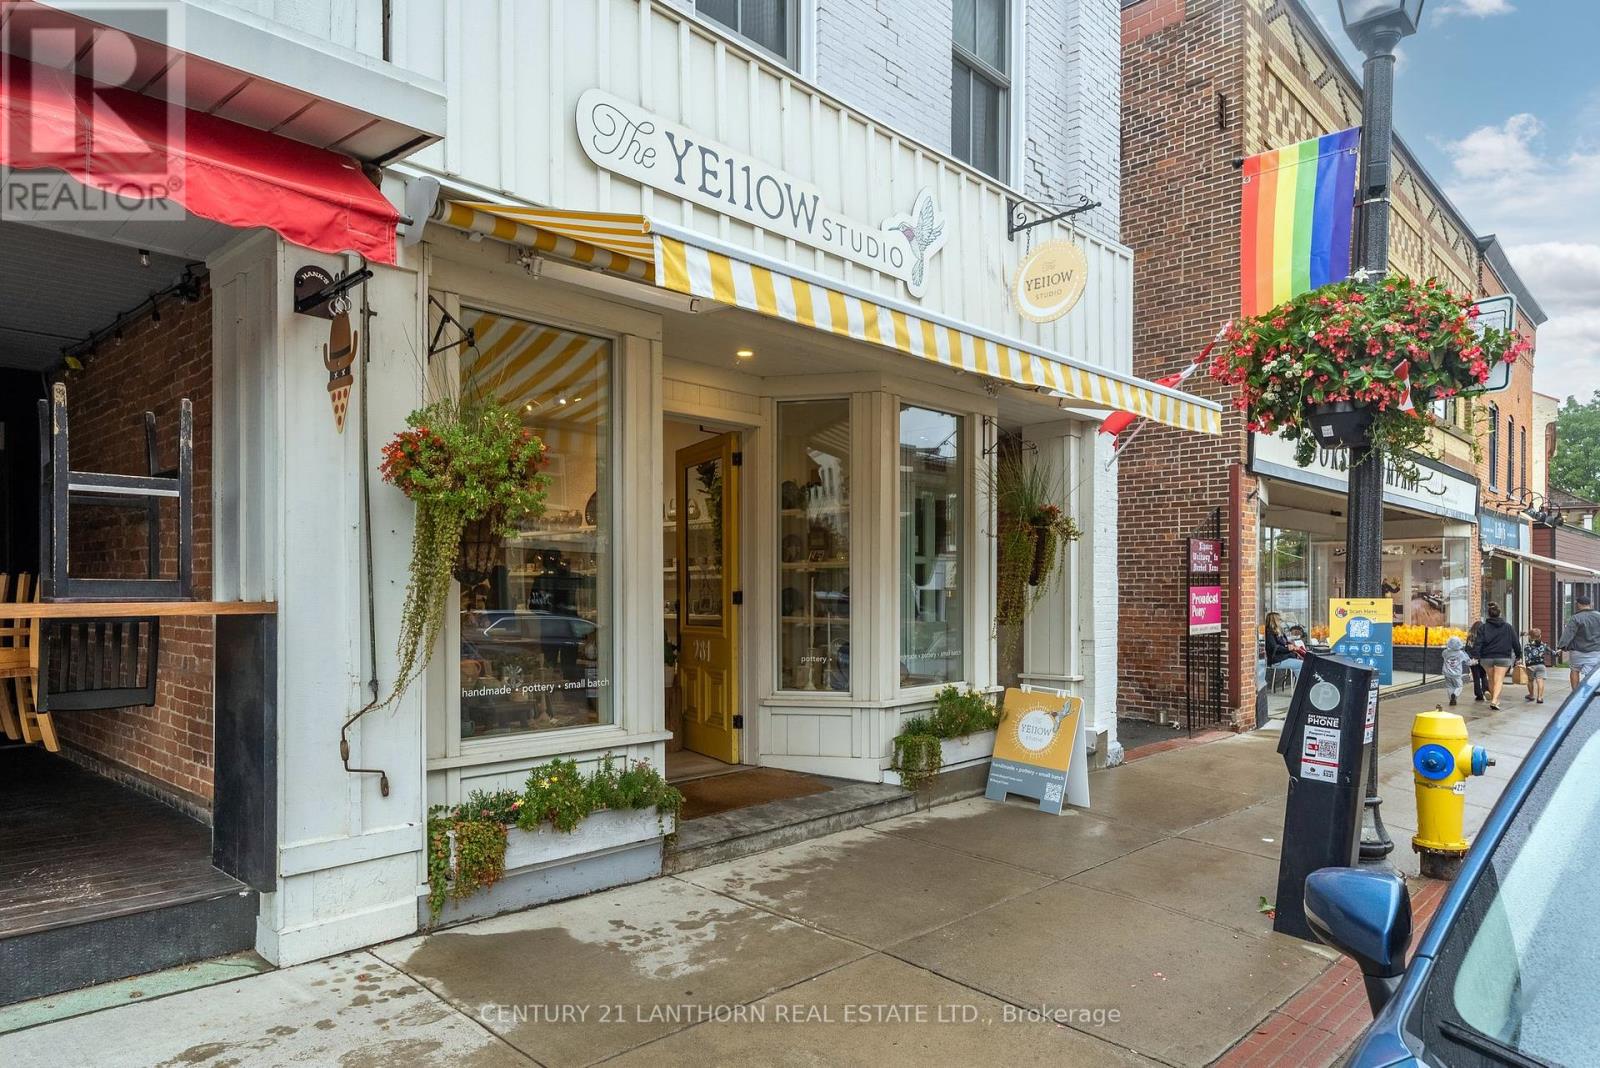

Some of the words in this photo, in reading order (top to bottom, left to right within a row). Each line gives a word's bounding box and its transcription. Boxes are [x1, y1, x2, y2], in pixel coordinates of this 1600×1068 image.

[591, 103, 656, 168] The
[822, 217, 904, 269] STUDIO
[1035, 289, 1062, 300] STUDIO
[1191, 605, 1206, 619] Pony
[800, 655, 828, 664] pottery
[461, 684, 512, 698] handmade
[522, 682, 555, 696] pottery
[564, 678, 586, 690] small
[587, 677, 610, 689] batch
[1307, 718, 1339, 728] PHONE
